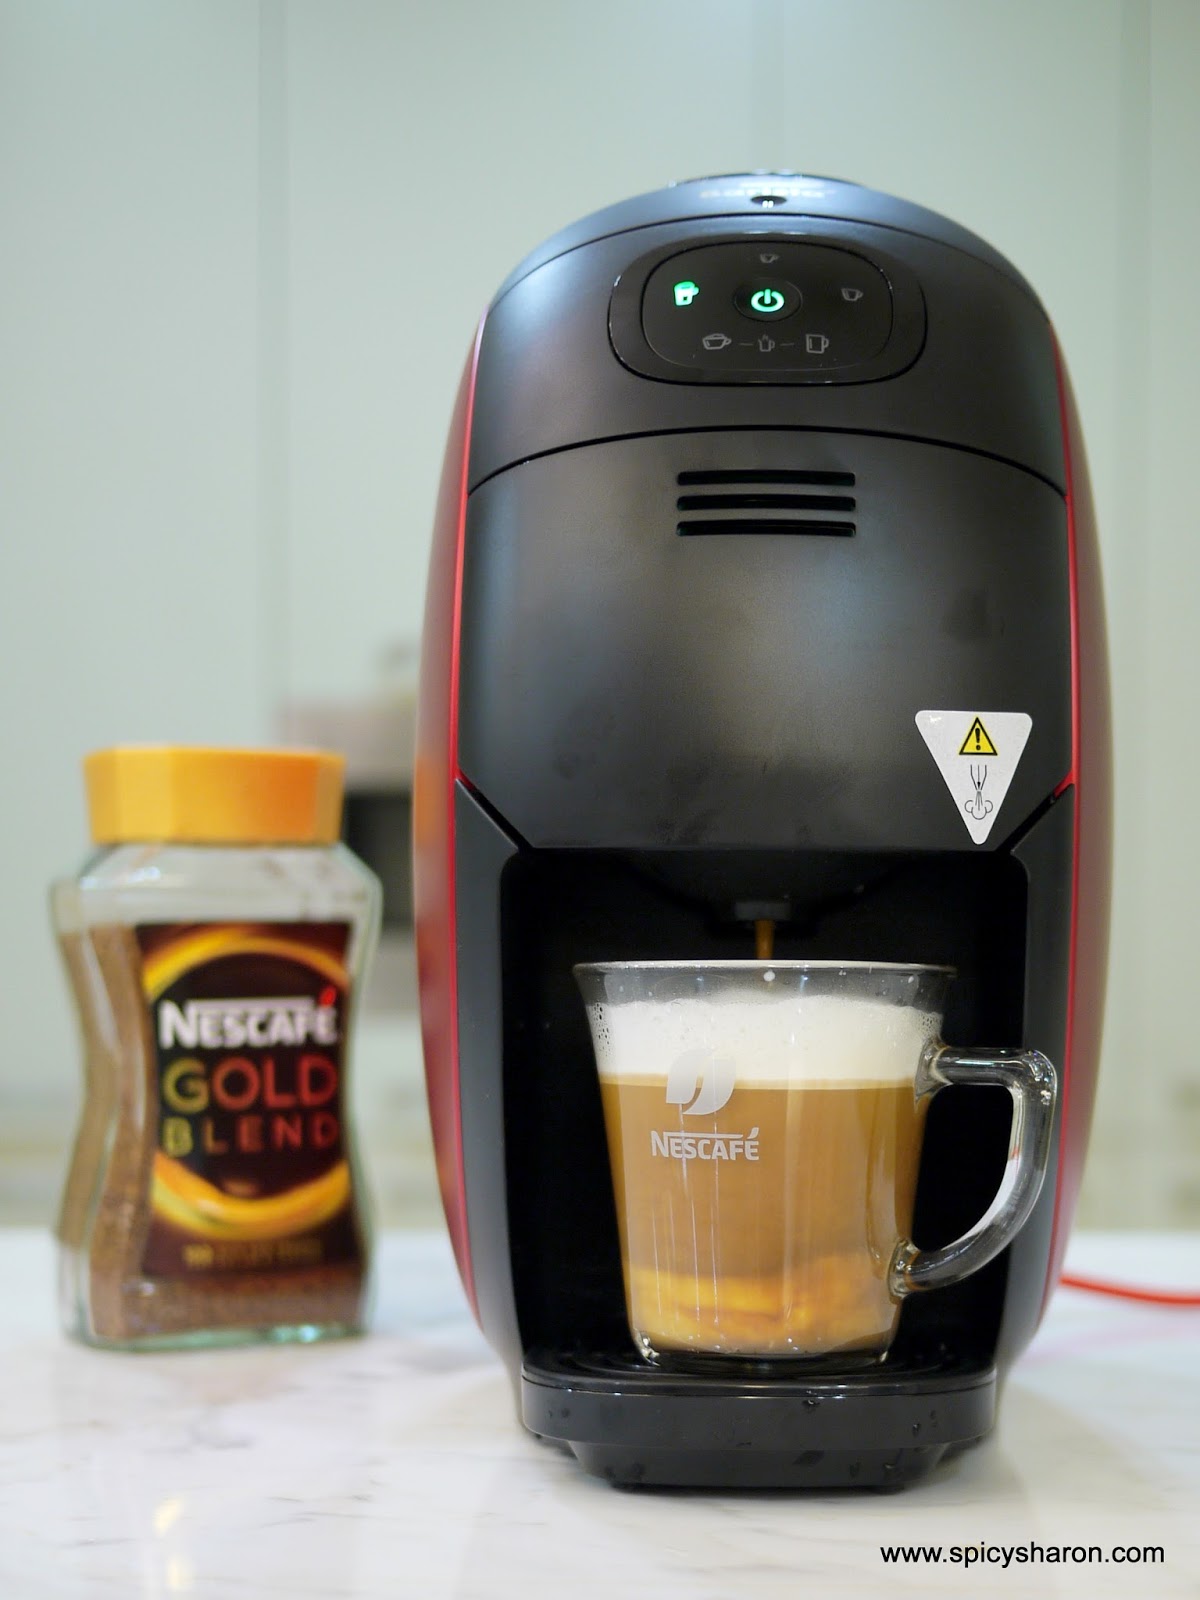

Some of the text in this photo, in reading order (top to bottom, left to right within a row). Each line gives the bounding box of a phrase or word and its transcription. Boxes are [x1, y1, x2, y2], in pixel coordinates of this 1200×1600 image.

[163, 1056, 339, 1112] GOLD
[162, 1114, 340, 1156] BLEND
[650, 1127, 760, 1161] NESCAFÉ
